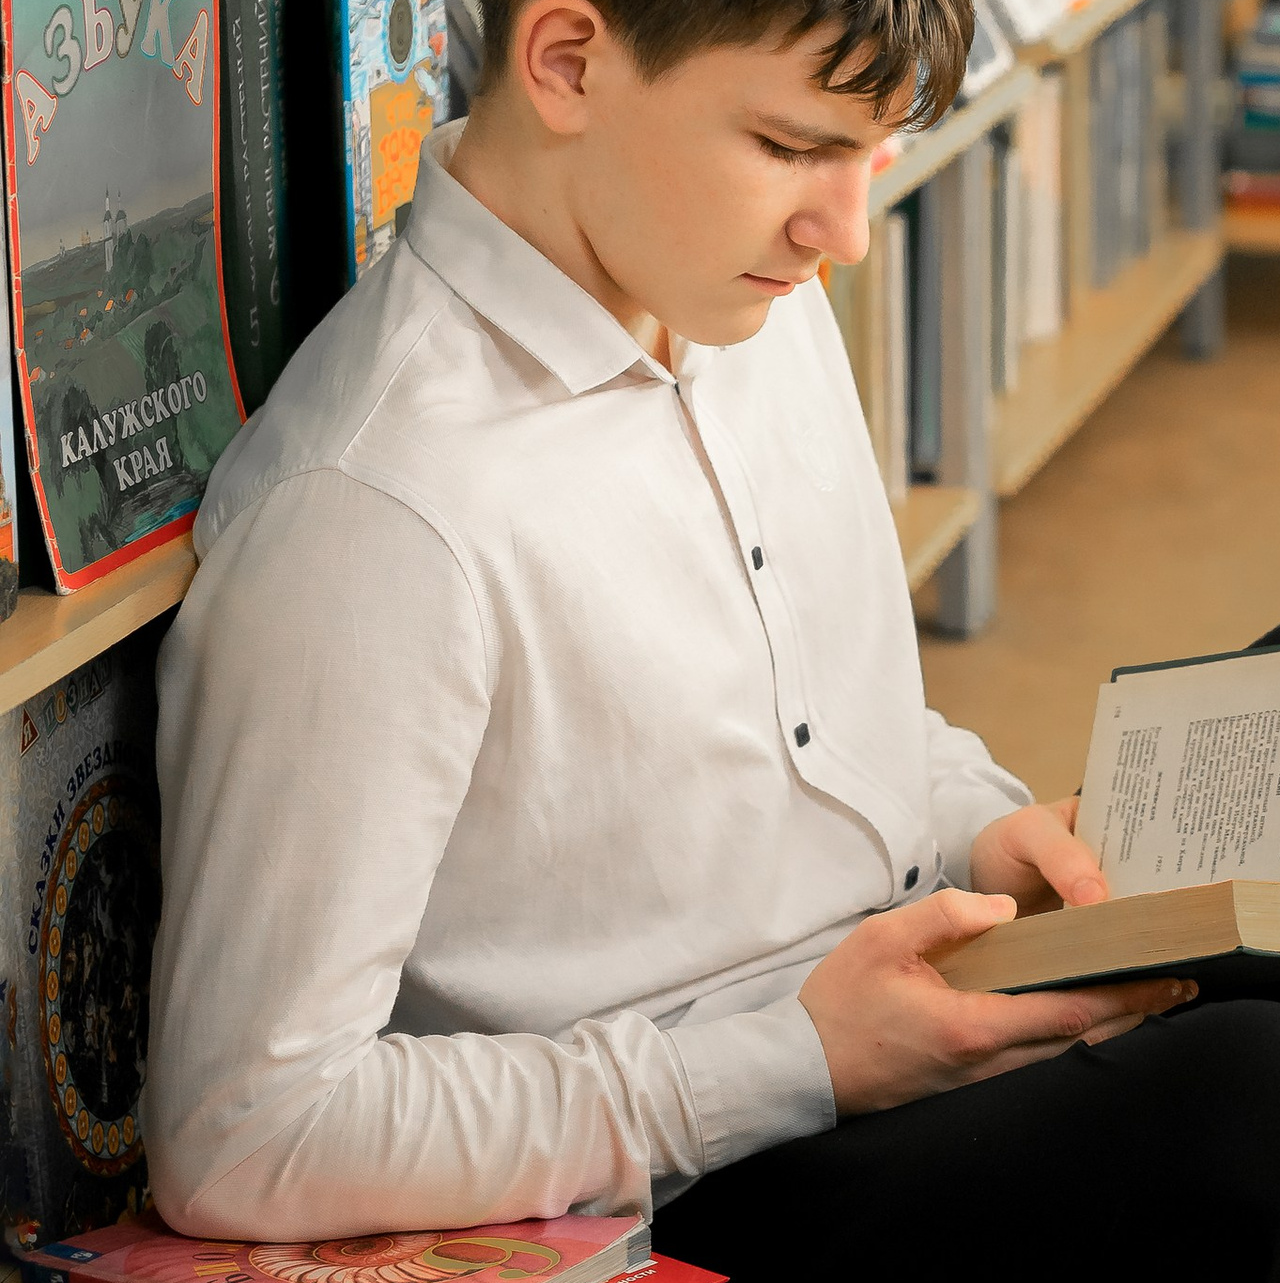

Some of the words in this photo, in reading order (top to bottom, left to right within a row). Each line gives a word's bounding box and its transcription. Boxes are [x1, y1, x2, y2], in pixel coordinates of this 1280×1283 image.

[59, 369, 208, 469] КАЛУЖСКОГО
[112, 435, 174, 493] КРАЯ
[28, 800, 66, 956] СКАЗКИ
